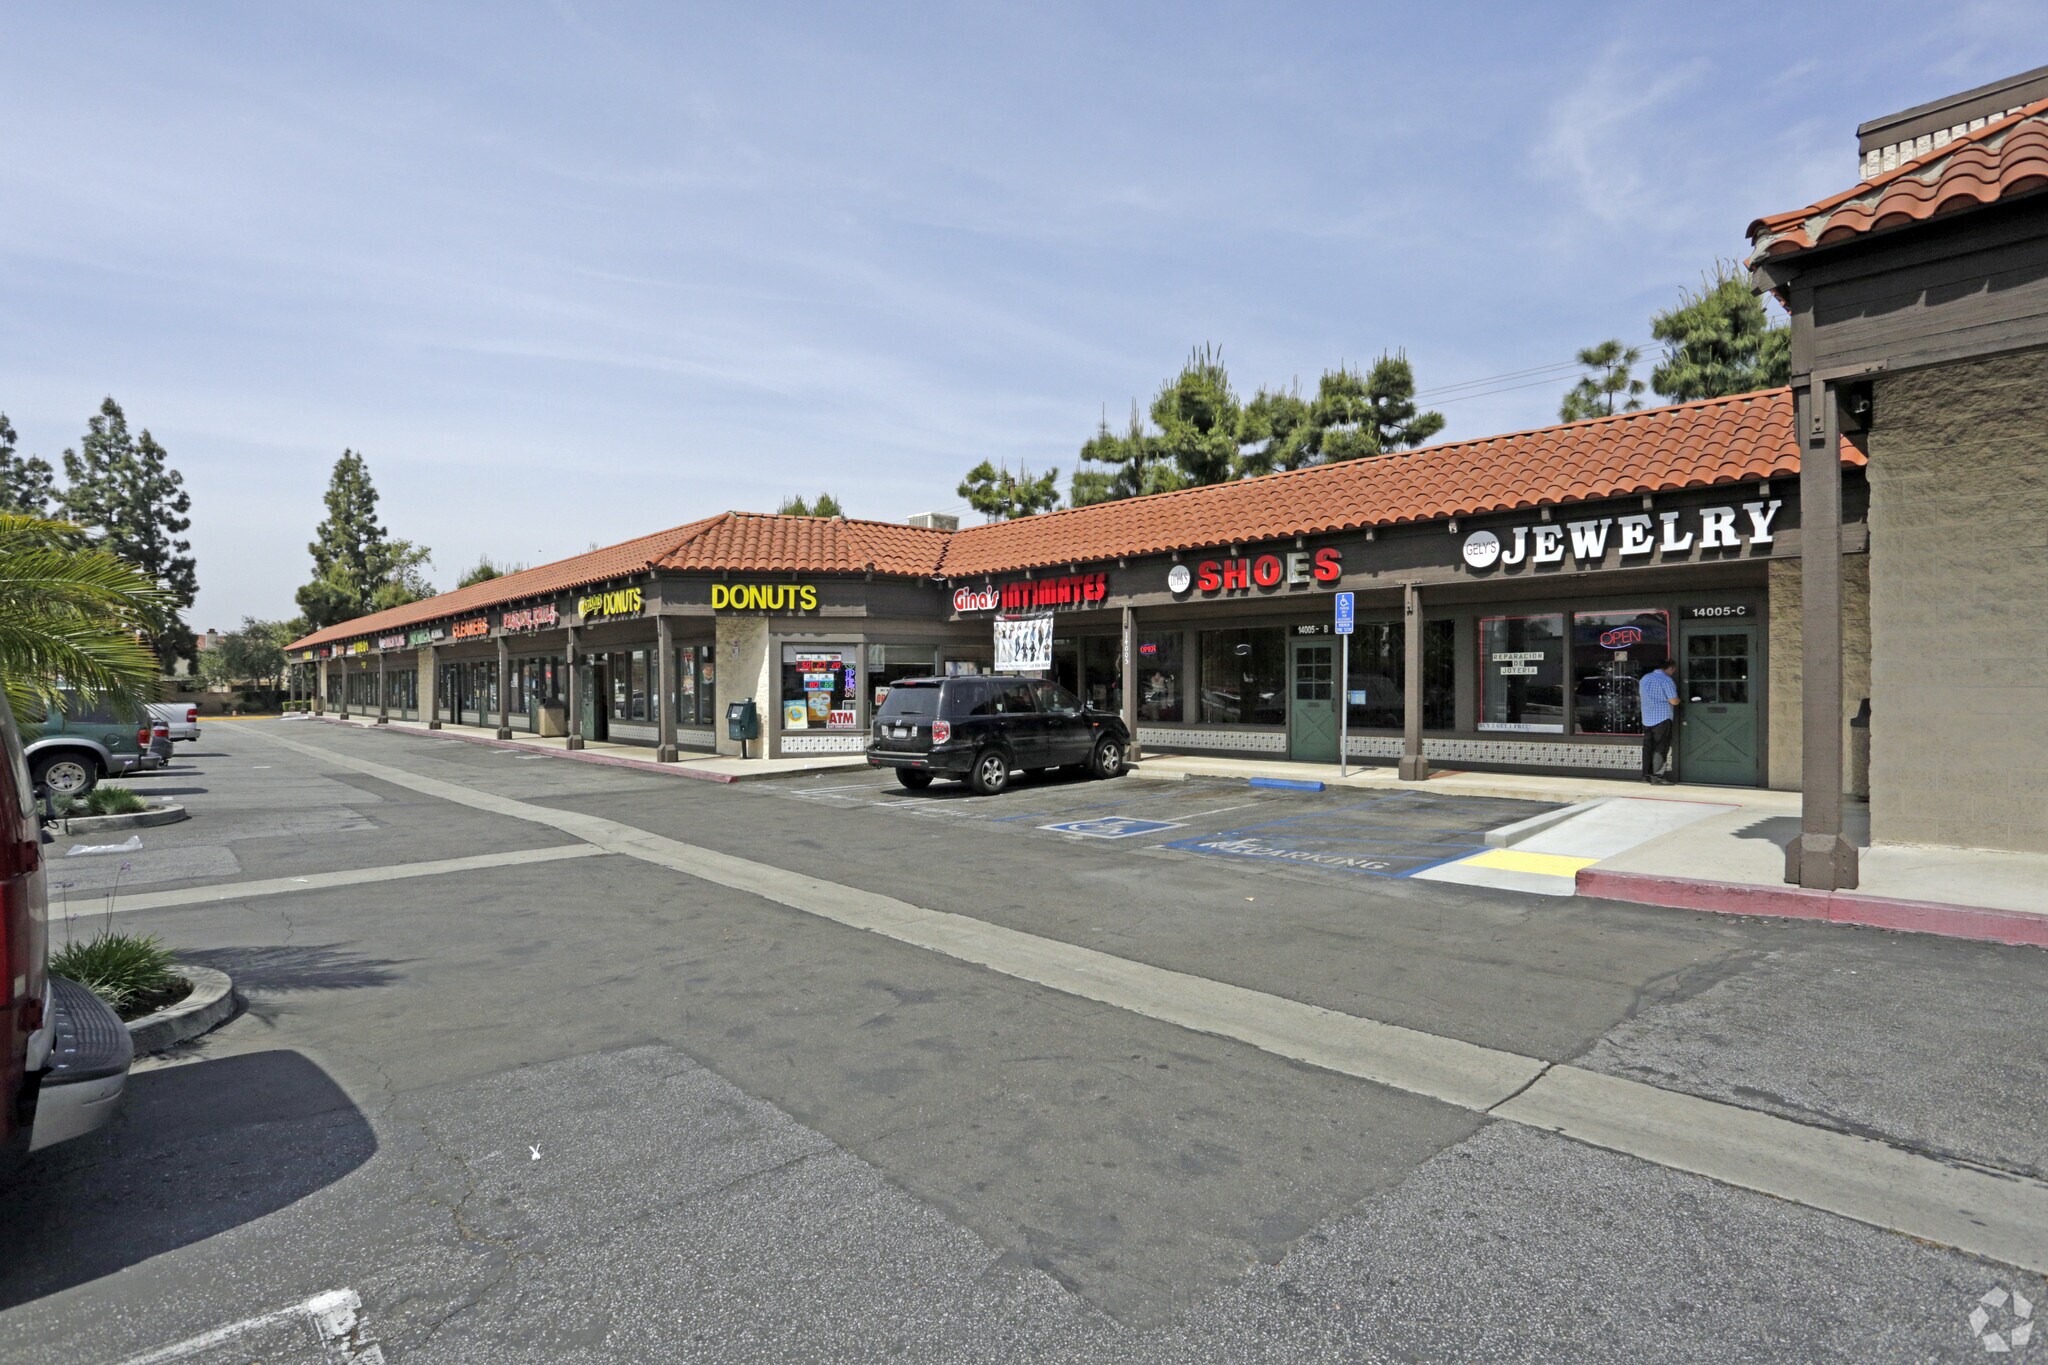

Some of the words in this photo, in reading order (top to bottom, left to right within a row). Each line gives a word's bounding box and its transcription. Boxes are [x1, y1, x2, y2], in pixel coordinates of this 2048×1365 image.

[1466, 540, 1497, 556] GELY'S
[1501, 500, 1782, 564] JEWELRY
[1198, 548, 1342, 591] SHOES
[603, 587, 642, 615] DONUTS
[712, 584, 817, 610] DONUTS
[953, 585, 999, 612] Gina's
[1002, 573, 1106, 609] INTIMATES
[1692, 606, 1746, 617] 14005-C
[1600, 630, 1642, 645] OPEN
[1140, 645, 1157, 653] OPEN
[1502, 666, 1536, 674] JOYERIA
[829, 712, 854, 724] ATM
